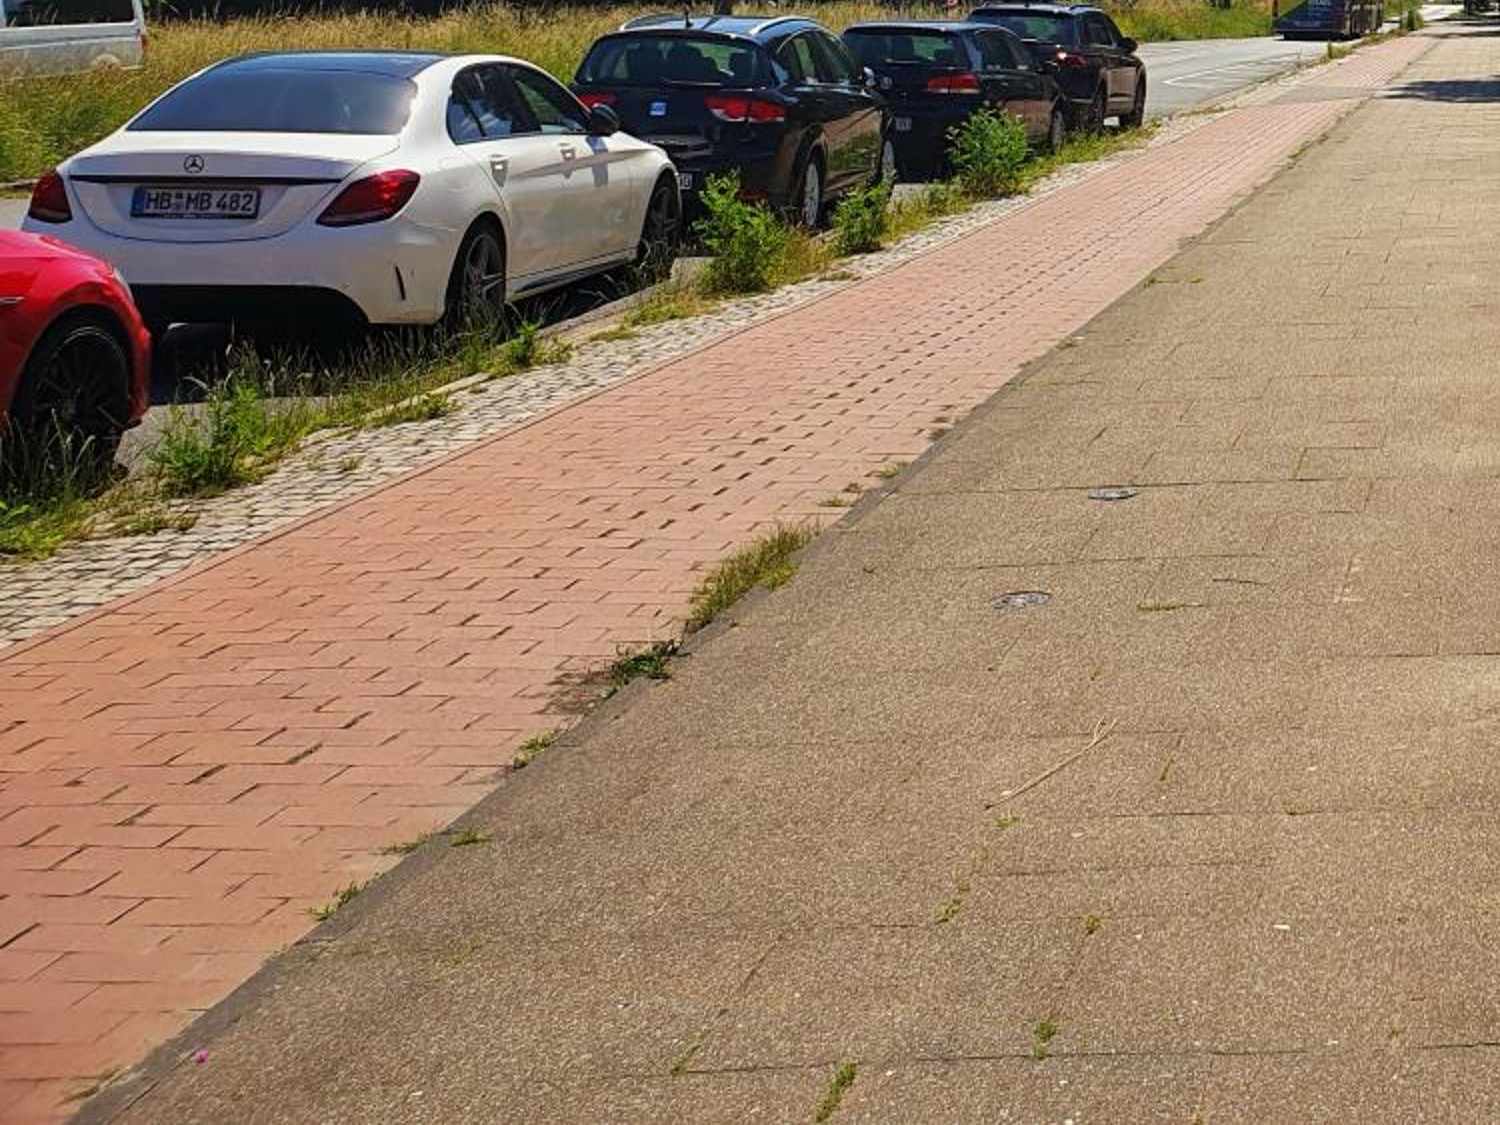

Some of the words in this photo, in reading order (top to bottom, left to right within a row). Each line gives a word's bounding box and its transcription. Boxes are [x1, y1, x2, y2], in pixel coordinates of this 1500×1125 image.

[145, 190, 172, 211] HB
[185, 191, 213, 213] MB
[216, 191, 255, 213] 482
